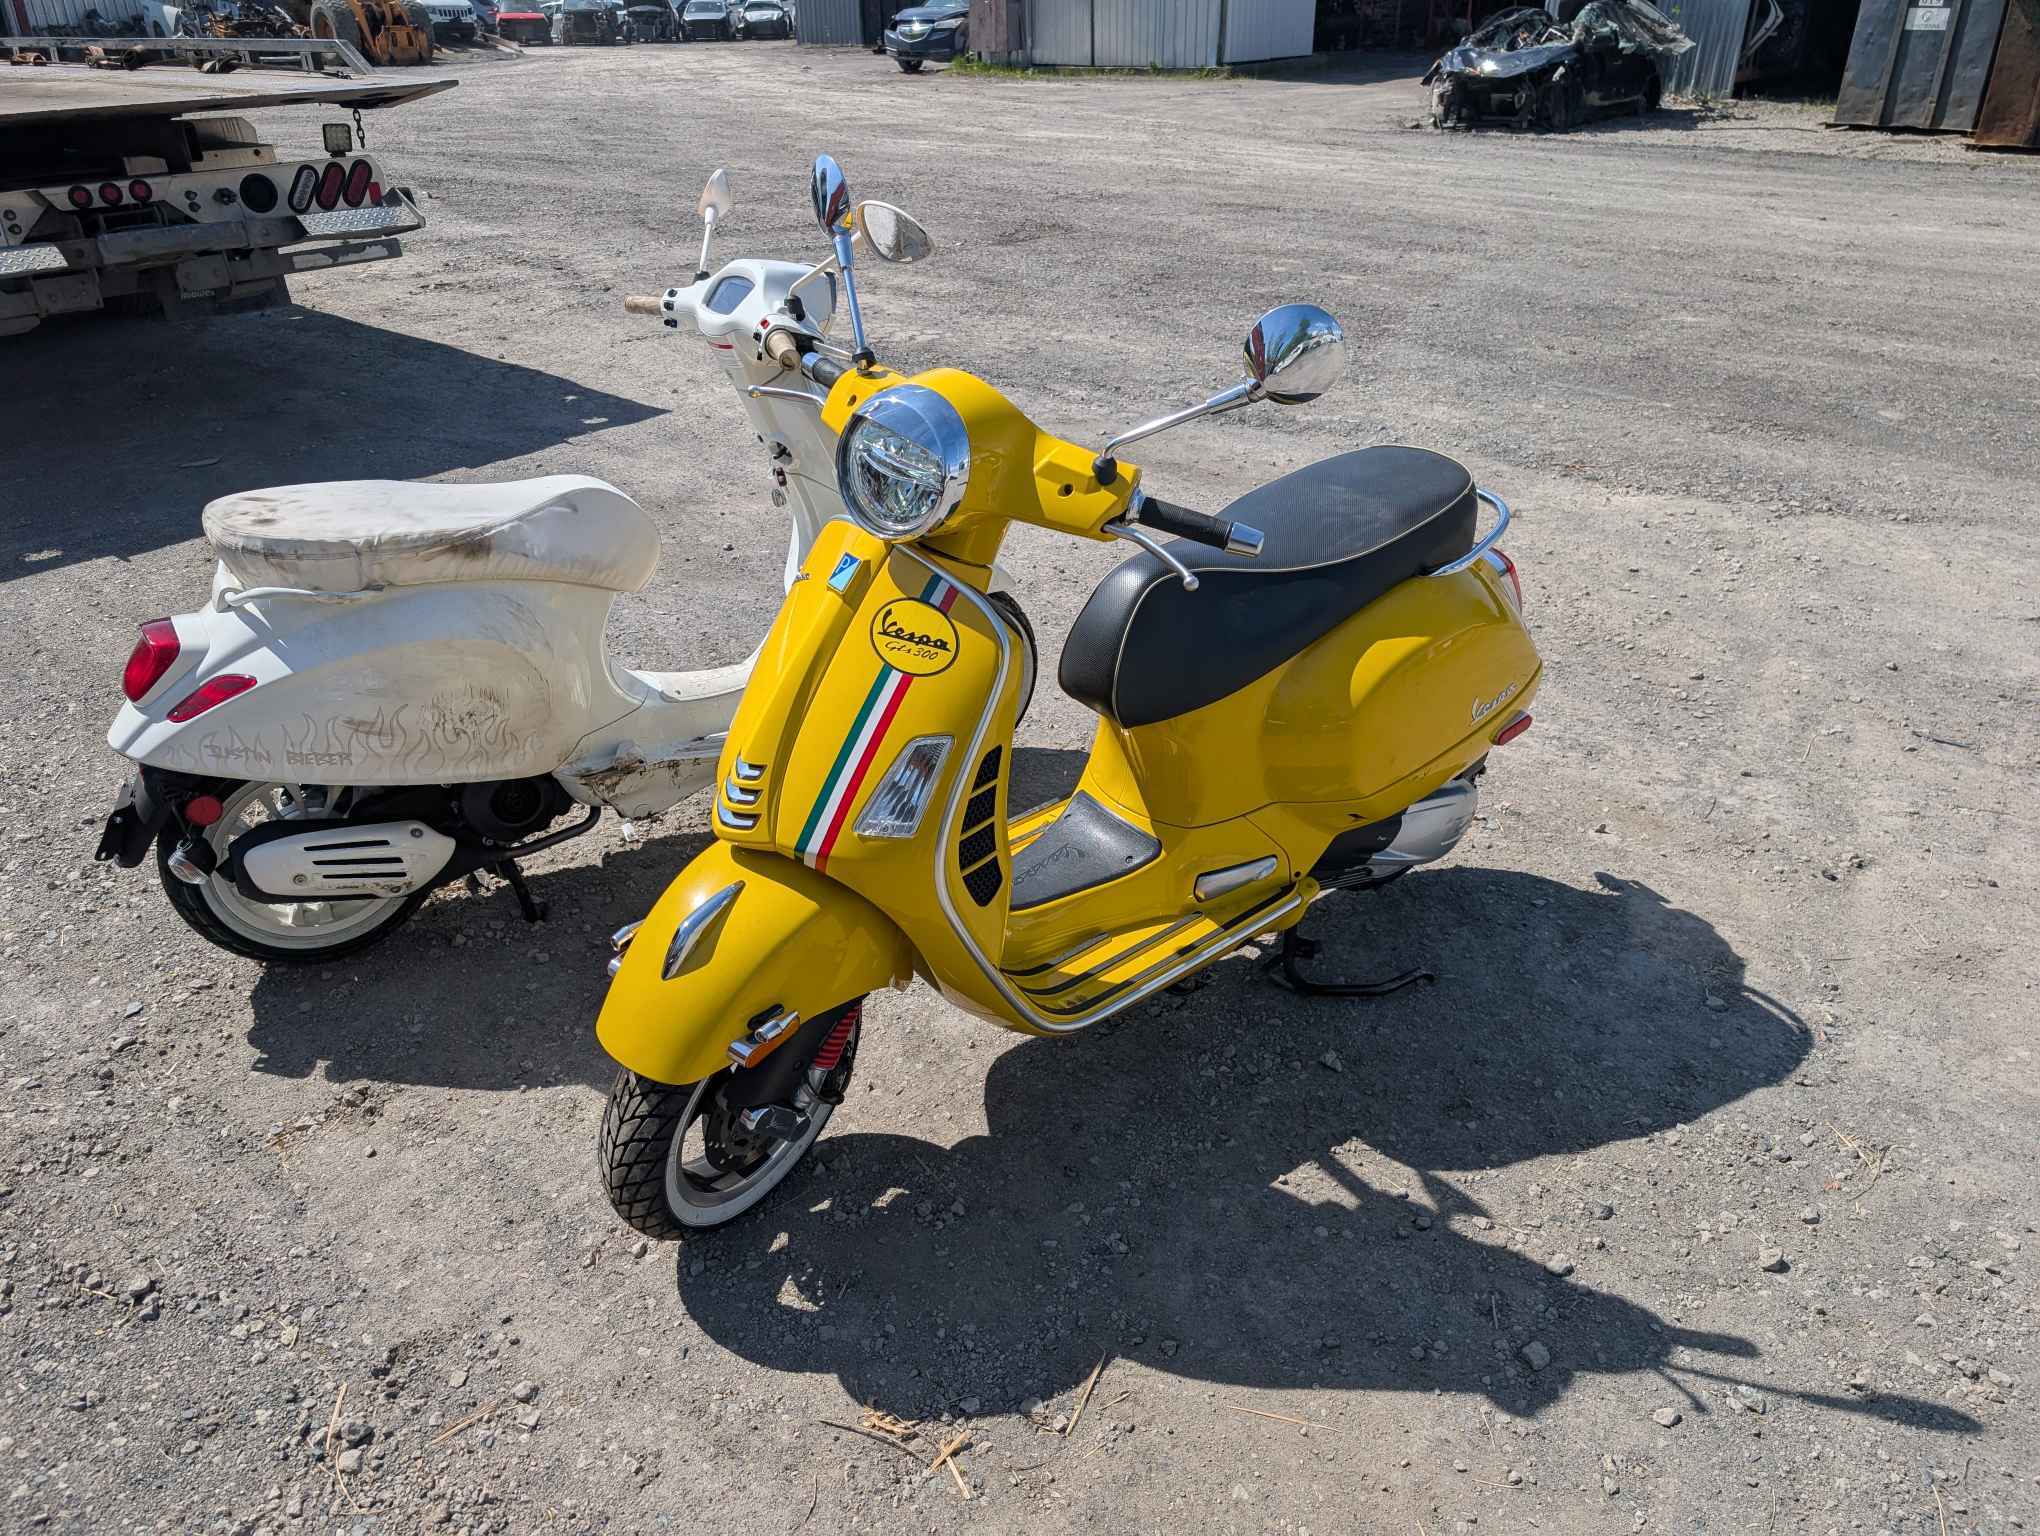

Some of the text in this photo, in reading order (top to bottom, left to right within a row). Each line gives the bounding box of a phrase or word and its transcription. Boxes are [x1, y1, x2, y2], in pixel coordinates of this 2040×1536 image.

[878, 608, 951, 652] Vespa
[913, 647, 938, 660] 300
[1471, 681, 1517, 726] Vespa
[286, 751, 353, 766] BIEBER
